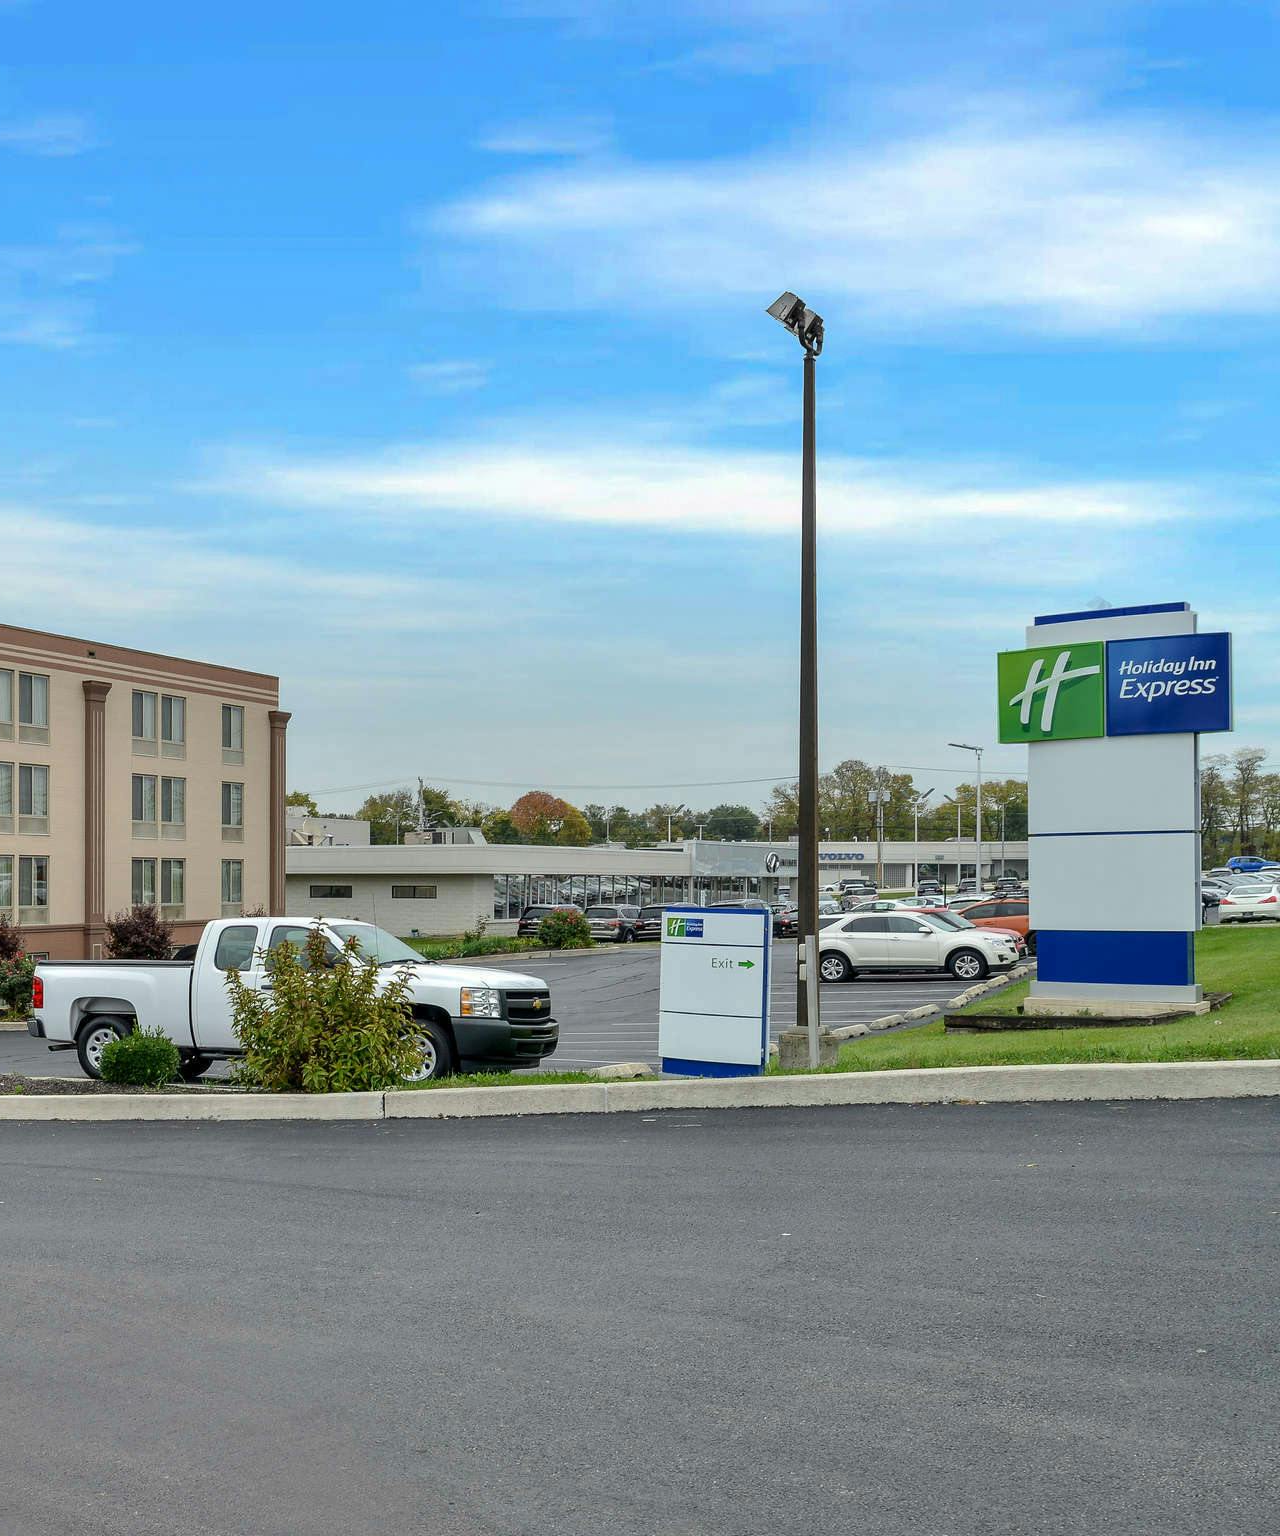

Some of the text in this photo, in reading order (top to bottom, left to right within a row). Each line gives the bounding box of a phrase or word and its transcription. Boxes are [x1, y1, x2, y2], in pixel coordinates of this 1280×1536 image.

[1119, 656, 1217, 676] Holiday Inn
[1119, 678, 1217, 702] Express
[818, 852, 865, 861] VOLVO
[711, 957, 734, 969] Exit
